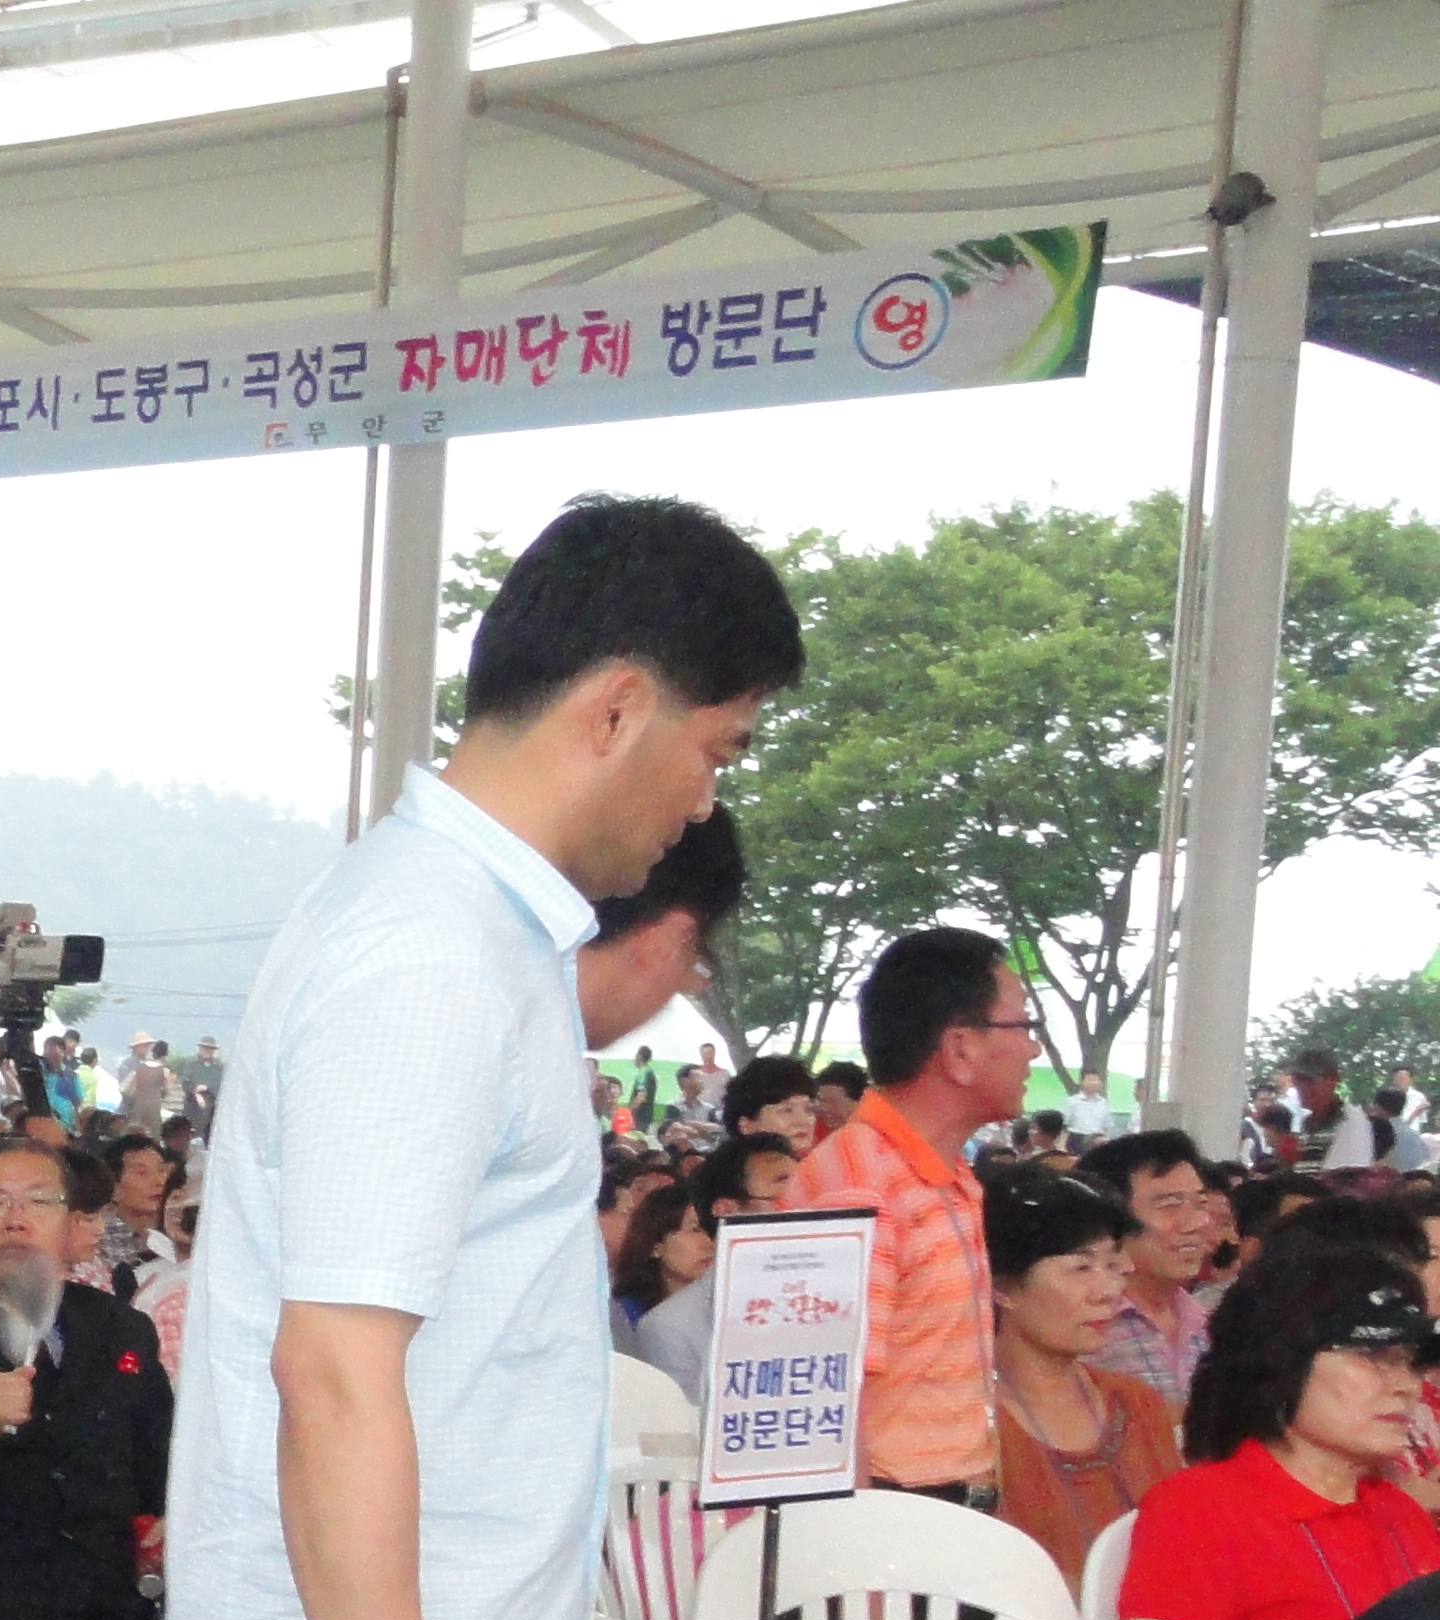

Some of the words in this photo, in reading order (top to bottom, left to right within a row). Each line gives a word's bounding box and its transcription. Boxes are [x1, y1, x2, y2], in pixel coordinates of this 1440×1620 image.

[394, 308, 634, 393] 자매단체
[659, 285, 828, 378] 방문단
[872, 294, 929, 353] 영
[722, 1351, 848, 1400] 자매단체
[722, 1403, 845, 1453] 방문단석
